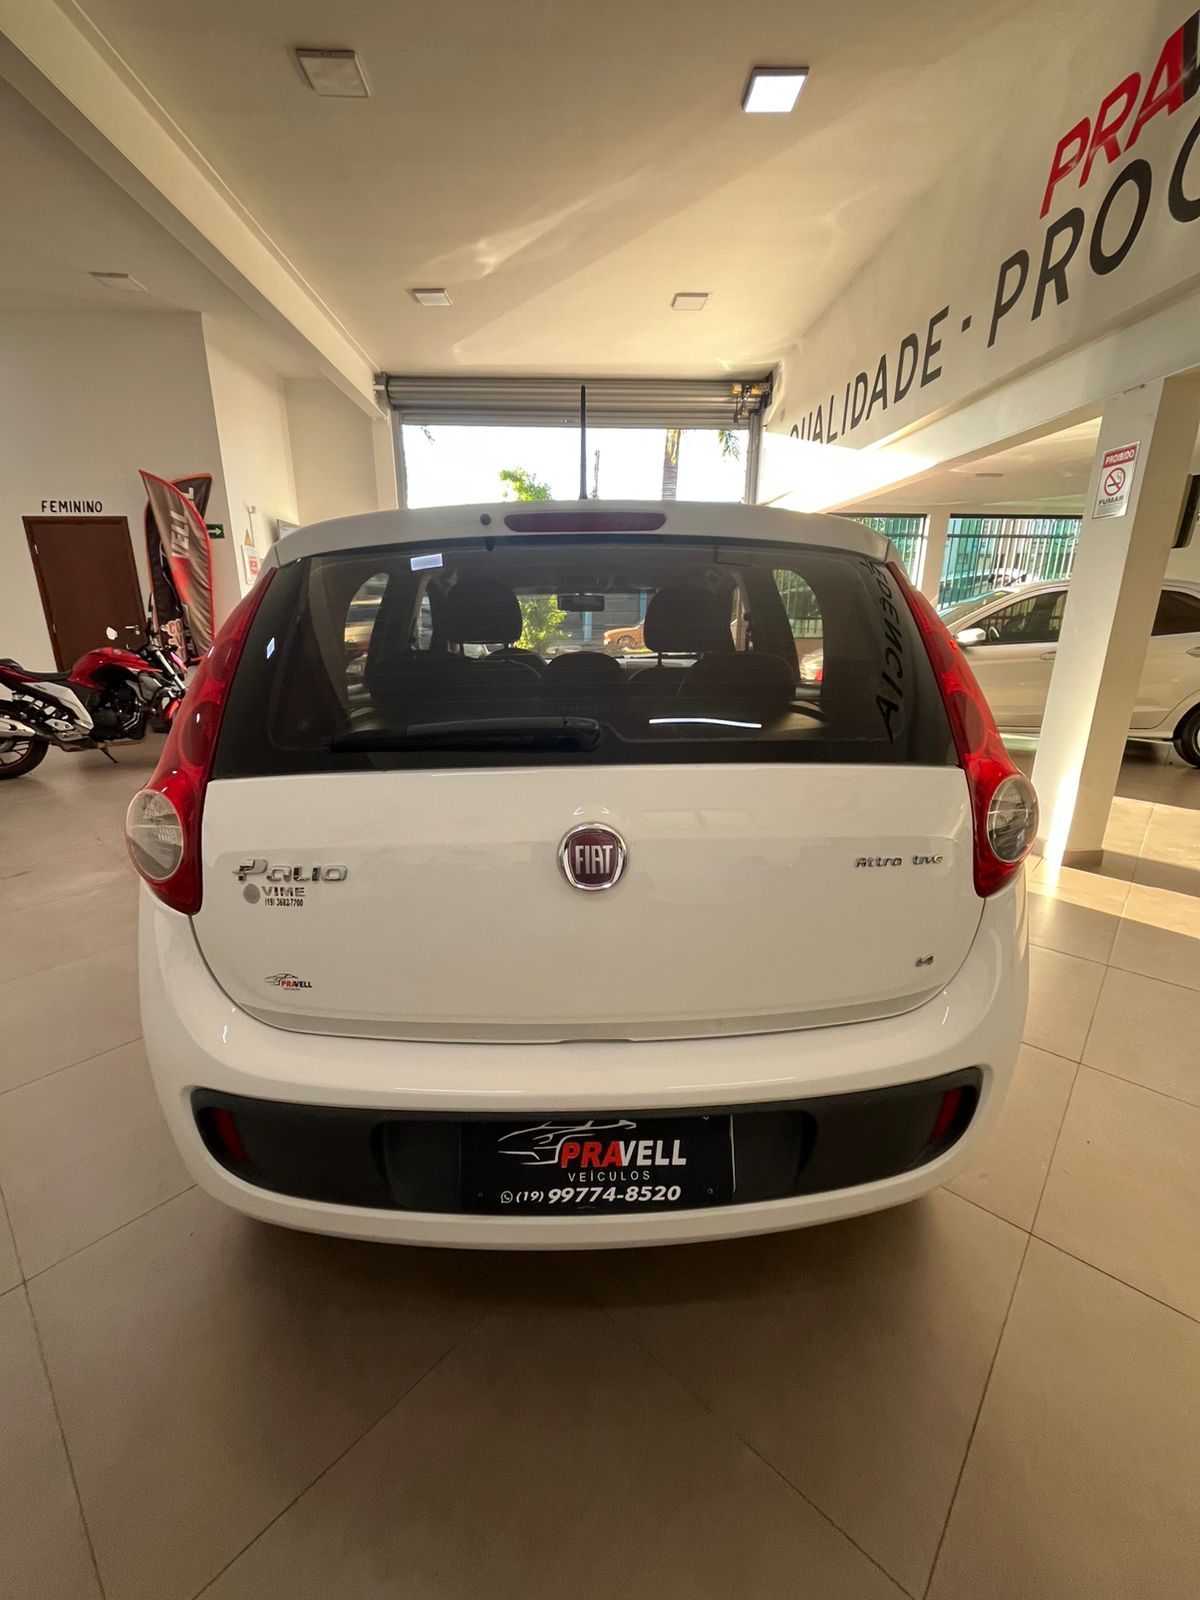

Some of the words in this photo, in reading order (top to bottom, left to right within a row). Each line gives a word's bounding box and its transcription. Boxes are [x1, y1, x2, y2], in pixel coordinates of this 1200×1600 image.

[1104, 449, 1135, 465] PROIBIDO
[41, 500, 103, 513] FEMININO
[1098, 495, 1124, 505] FUMAR
[575, 845, 614, 875] FIAT
[261, 886, 306, 897] VIME
[560, 1139, 687, 1169] PRAVELL
[568, 1170, 651, 1182] VEÍCULOS
[515, 1191, 544, 1203] (19)
[548, 1185, 682, 1204] 99774-8520
